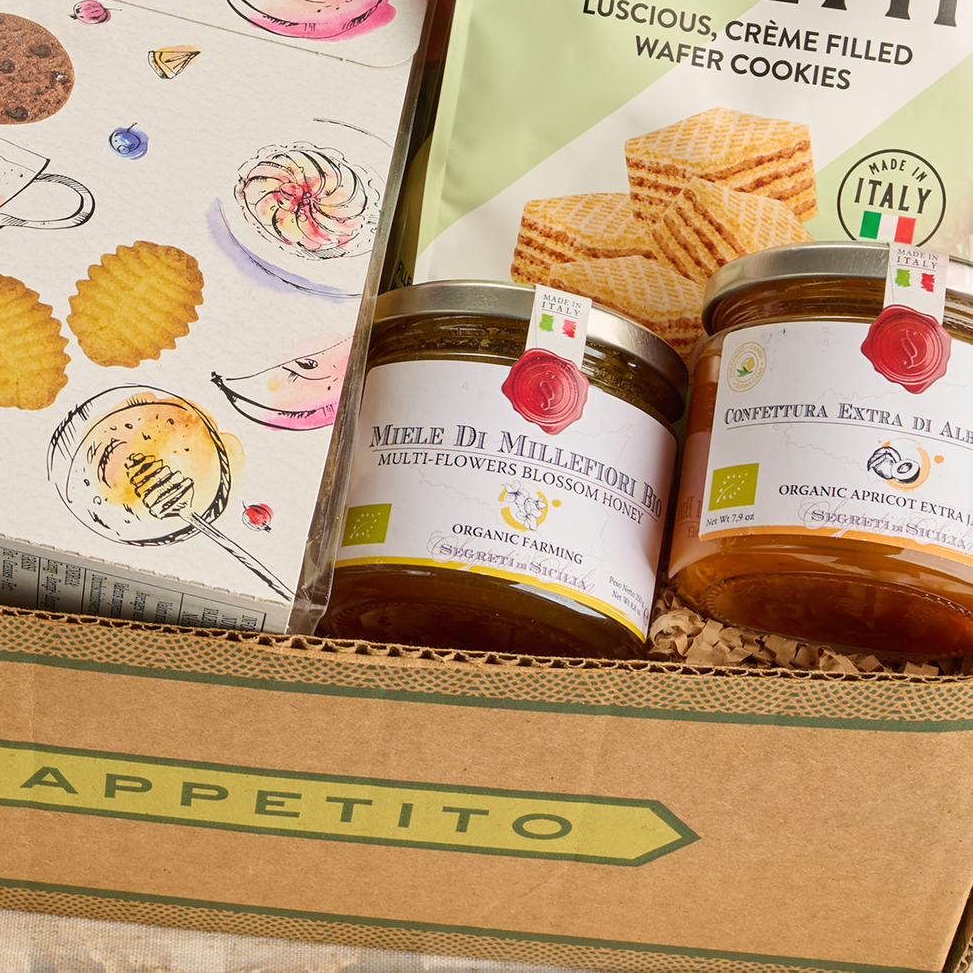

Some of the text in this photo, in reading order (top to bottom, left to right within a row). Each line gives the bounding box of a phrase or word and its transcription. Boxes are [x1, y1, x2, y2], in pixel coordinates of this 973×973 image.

[725, 19, 819, 54] CRÈME
[825, 32, 914, 67] FILLED
[634, 34, 852, 92] WAFER COOKIES
[868, 158, 928, 183] MADE IN
[854, 177, 932, 214] ITALY
[896, 255, 938, 270] ITALY
[897, 248, 939, 262] MADE IN
[542, 301, 581, 317] ITALY
[543, 293, 582, 309] MADE IN
[724, 403, 932, 433] CONFETTURA EXTRA DI
[369, 424, 445, 447] MIELE
[497, 430, 637, 498] MILLEFIORI
[641, 481, 663, 518] BIO
[377, 451, 518, 476] MULTI-FLOWERS
[522, 465, 599, 501] BLOSSOM
[602, 492, 644, 524] HONEY
[706, 518, 718, 527] Net
[719, 514, 730, 524] Wt
[745, 513, 755, 521] oz
[778, 484, 847, 499] ORGANIC
[850, 489, 917, 510] APRICOT
[920, 501, 964, 523] EXTRA
[452, 523, 583, 565] ORGANIC FARMING
[810, 509, 890, 530] SEGRETI
[905, 522, 967, 551] SICILIA
[439, 543, 515, 567] SEGRETI
[529, 560, 588, 591] SICILIA
[21, 764, 573, 843] APPETITO
